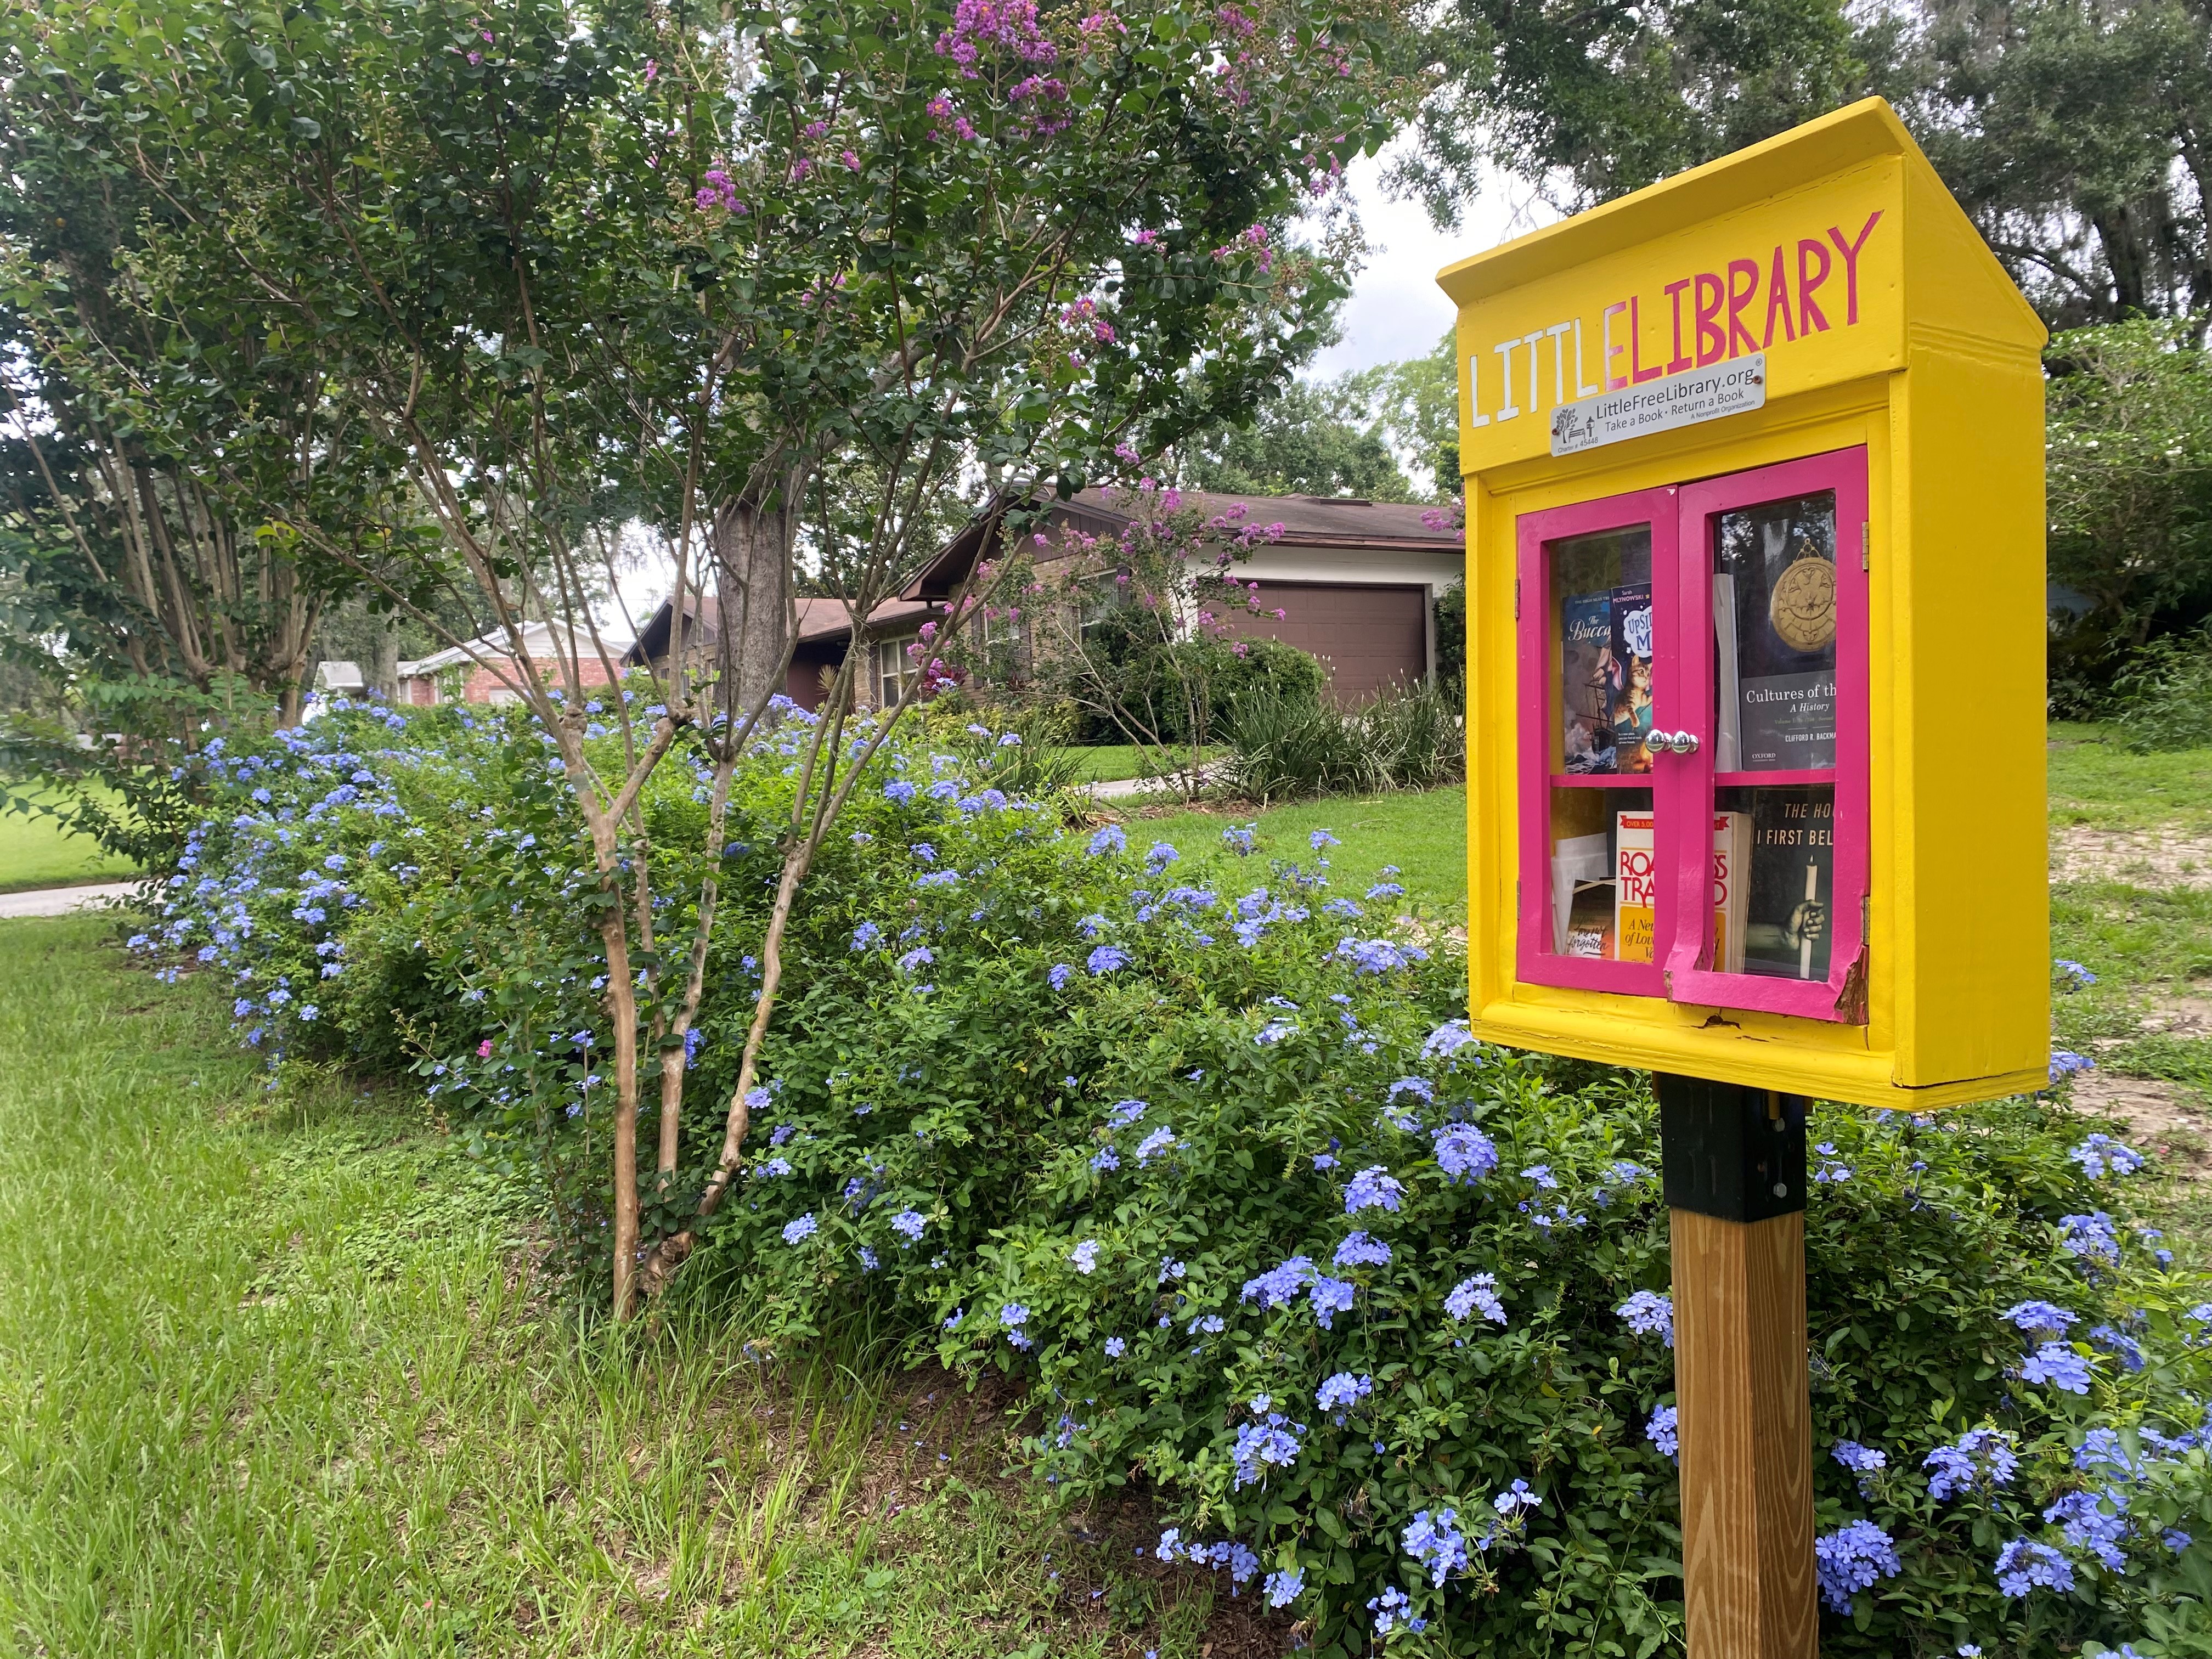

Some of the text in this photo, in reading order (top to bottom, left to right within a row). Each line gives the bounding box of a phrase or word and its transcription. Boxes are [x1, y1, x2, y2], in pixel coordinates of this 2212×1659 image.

[1597, 369, 1754, 419] LittleFreeLibrary.org
[1605, 388, 1743, 432] Take a Book Return a Book
[1696, 408, 1719, 417] Nonprofit
[1720, 400, 1755, 412] Organization
[1579, 436, 1599, 447] 45448
[1613, 594, 1644, 603] MLYNOWSKI
[1588, 615, 1599, 625] The
[1746, 689, 1804, 703] Cultures
[1808, 684, 1821, 698] of
[1790, 703, 1830, 713] A History
[1785, 733, 1809, 742] CLIFFORD
[1785, 803, 1831, 818] THE HO
[1757, 830, 1833, 846] I FIRST BEL
[1628, 918, 1635, 930] A
[1567, 935, 1610, 953] forgotten
[1625, 932, 1635, 946] of
